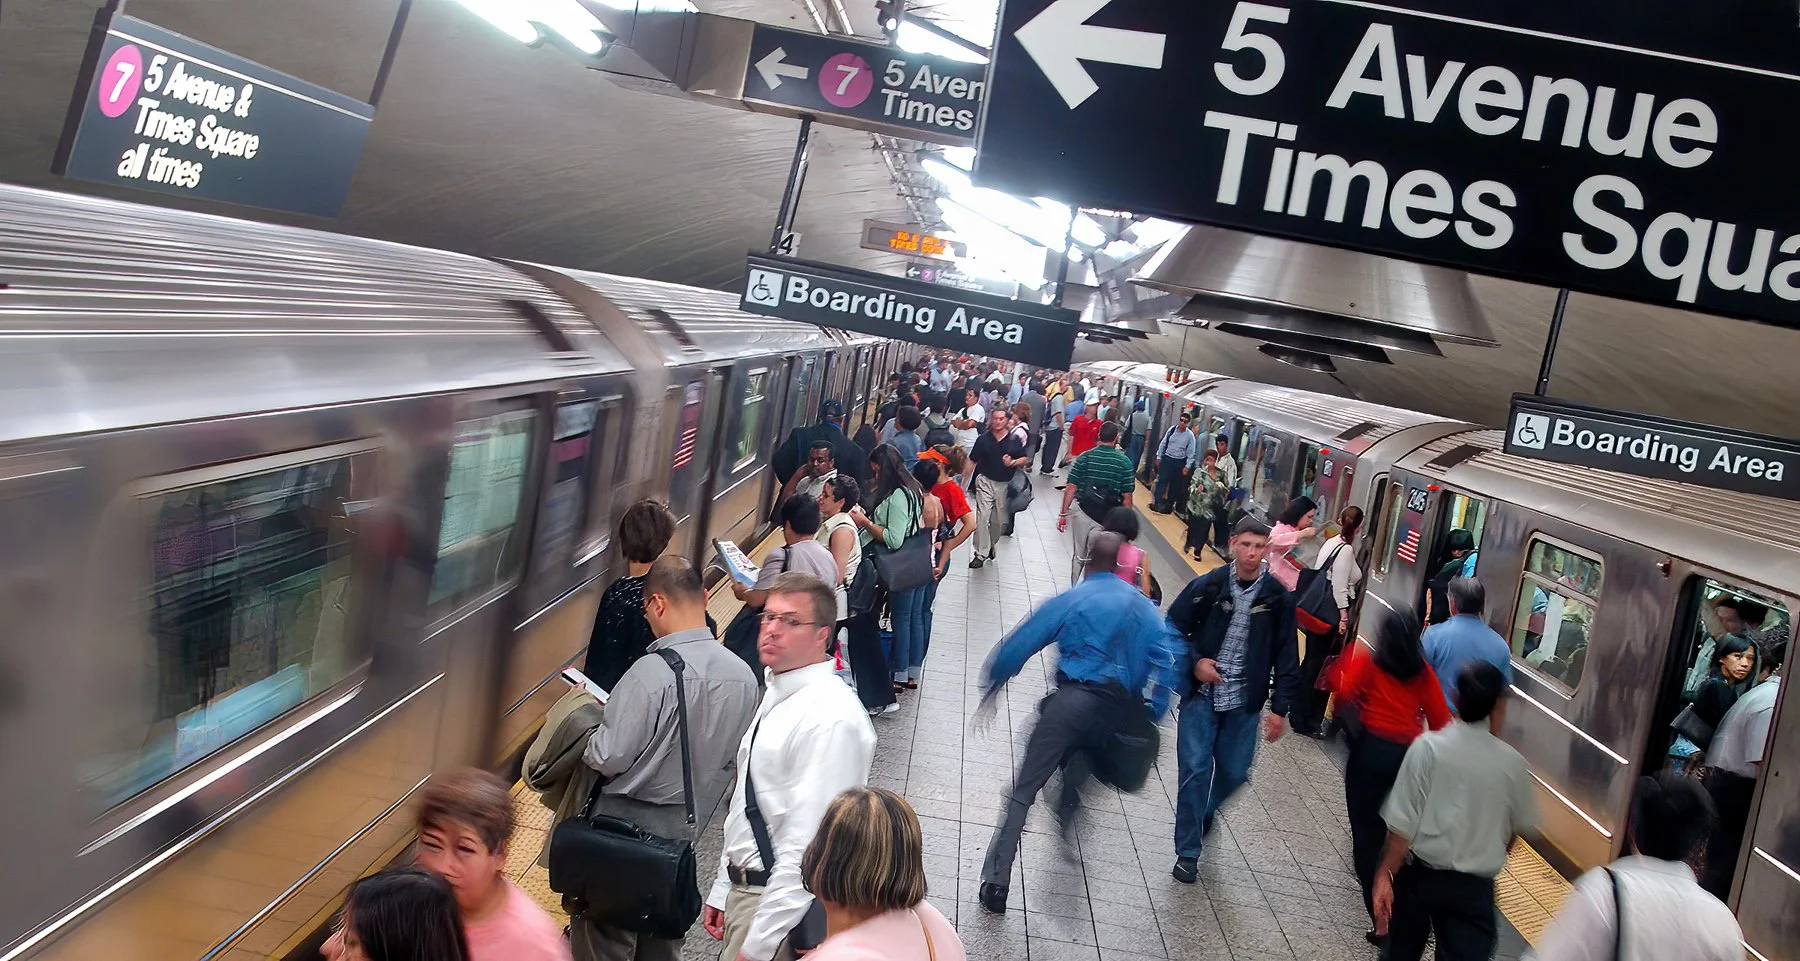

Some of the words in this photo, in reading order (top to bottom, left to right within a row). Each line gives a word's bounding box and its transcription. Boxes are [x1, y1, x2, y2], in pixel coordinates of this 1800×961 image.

[109, 62, 135, 103] 7
[143, 54, 168, 92] 5
[163, 61, 236, 112] Avenue
[234, 83, 253, 117] &
[836, 65, 862, 96] 7
[883, 59, 908, 87] 5
[1214, 1, 1289, 96] 5
[1326, 23, 1718, 169] Avenue
[133, 98, 196, 146] Times
[195, 114, 259, 160] Square
[882, 88, 975, 131] Times
[116, 143, 151, 180] all
[146, 147, 203, 189] times
[1203, 111, 1518, 251] Times
[779, 233, 794, 255] 4
[785, 275, 937, 335] Boarding
[944, 306, 1024, 346] Area
[1551, 418, 1700, 474] Boarding
[1708, 446, 1785, 482] Area
